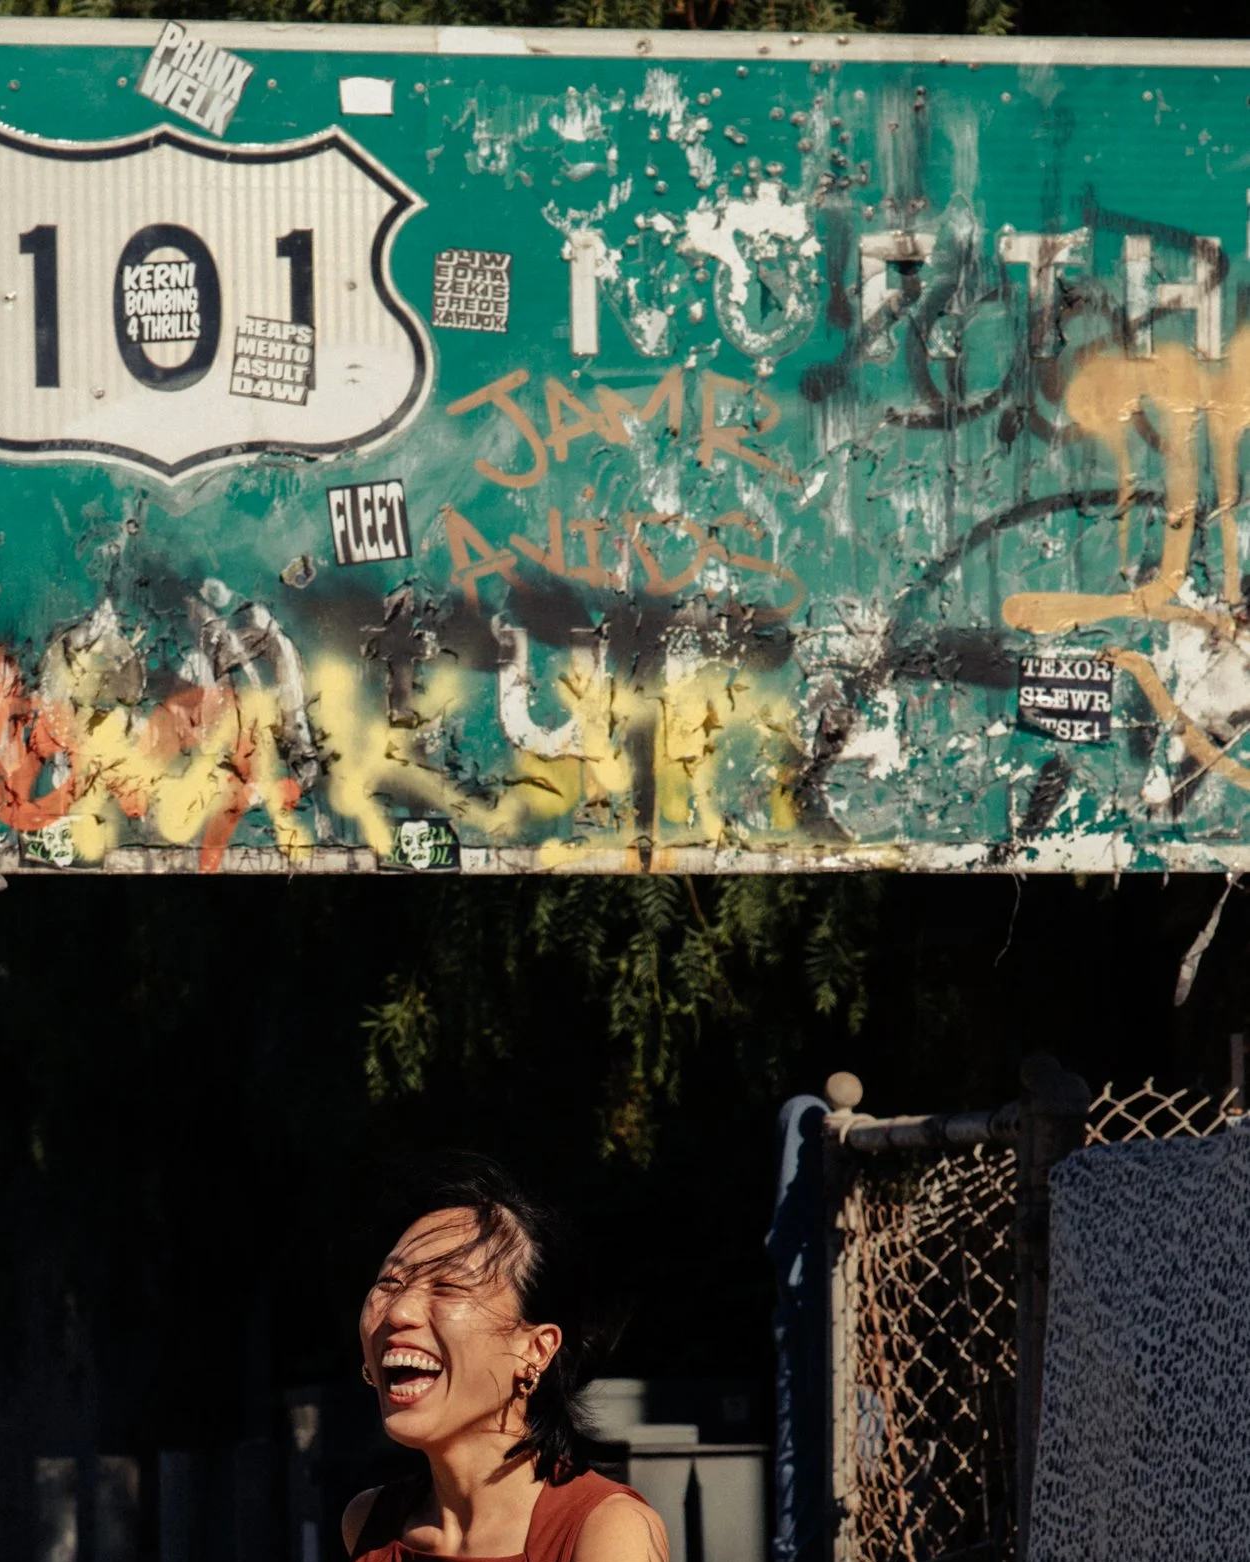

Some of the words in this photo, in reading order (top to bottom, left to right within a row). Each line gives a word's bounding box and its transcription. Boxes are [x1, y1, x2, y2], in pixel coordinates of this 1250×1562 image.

[123, 263, 197, 290] KERNI
[19, 223, 315, 392] 101
[124, 287, 199, 316] BOMBING
[127, 316, 139, 341] 4
[142, 313, 200, 341] THRILLS
[234, 357, 310, 383] ASULT
[329, 481, 408, 564] FLEET
[1021, 658, 1111, 681] TEXOR
